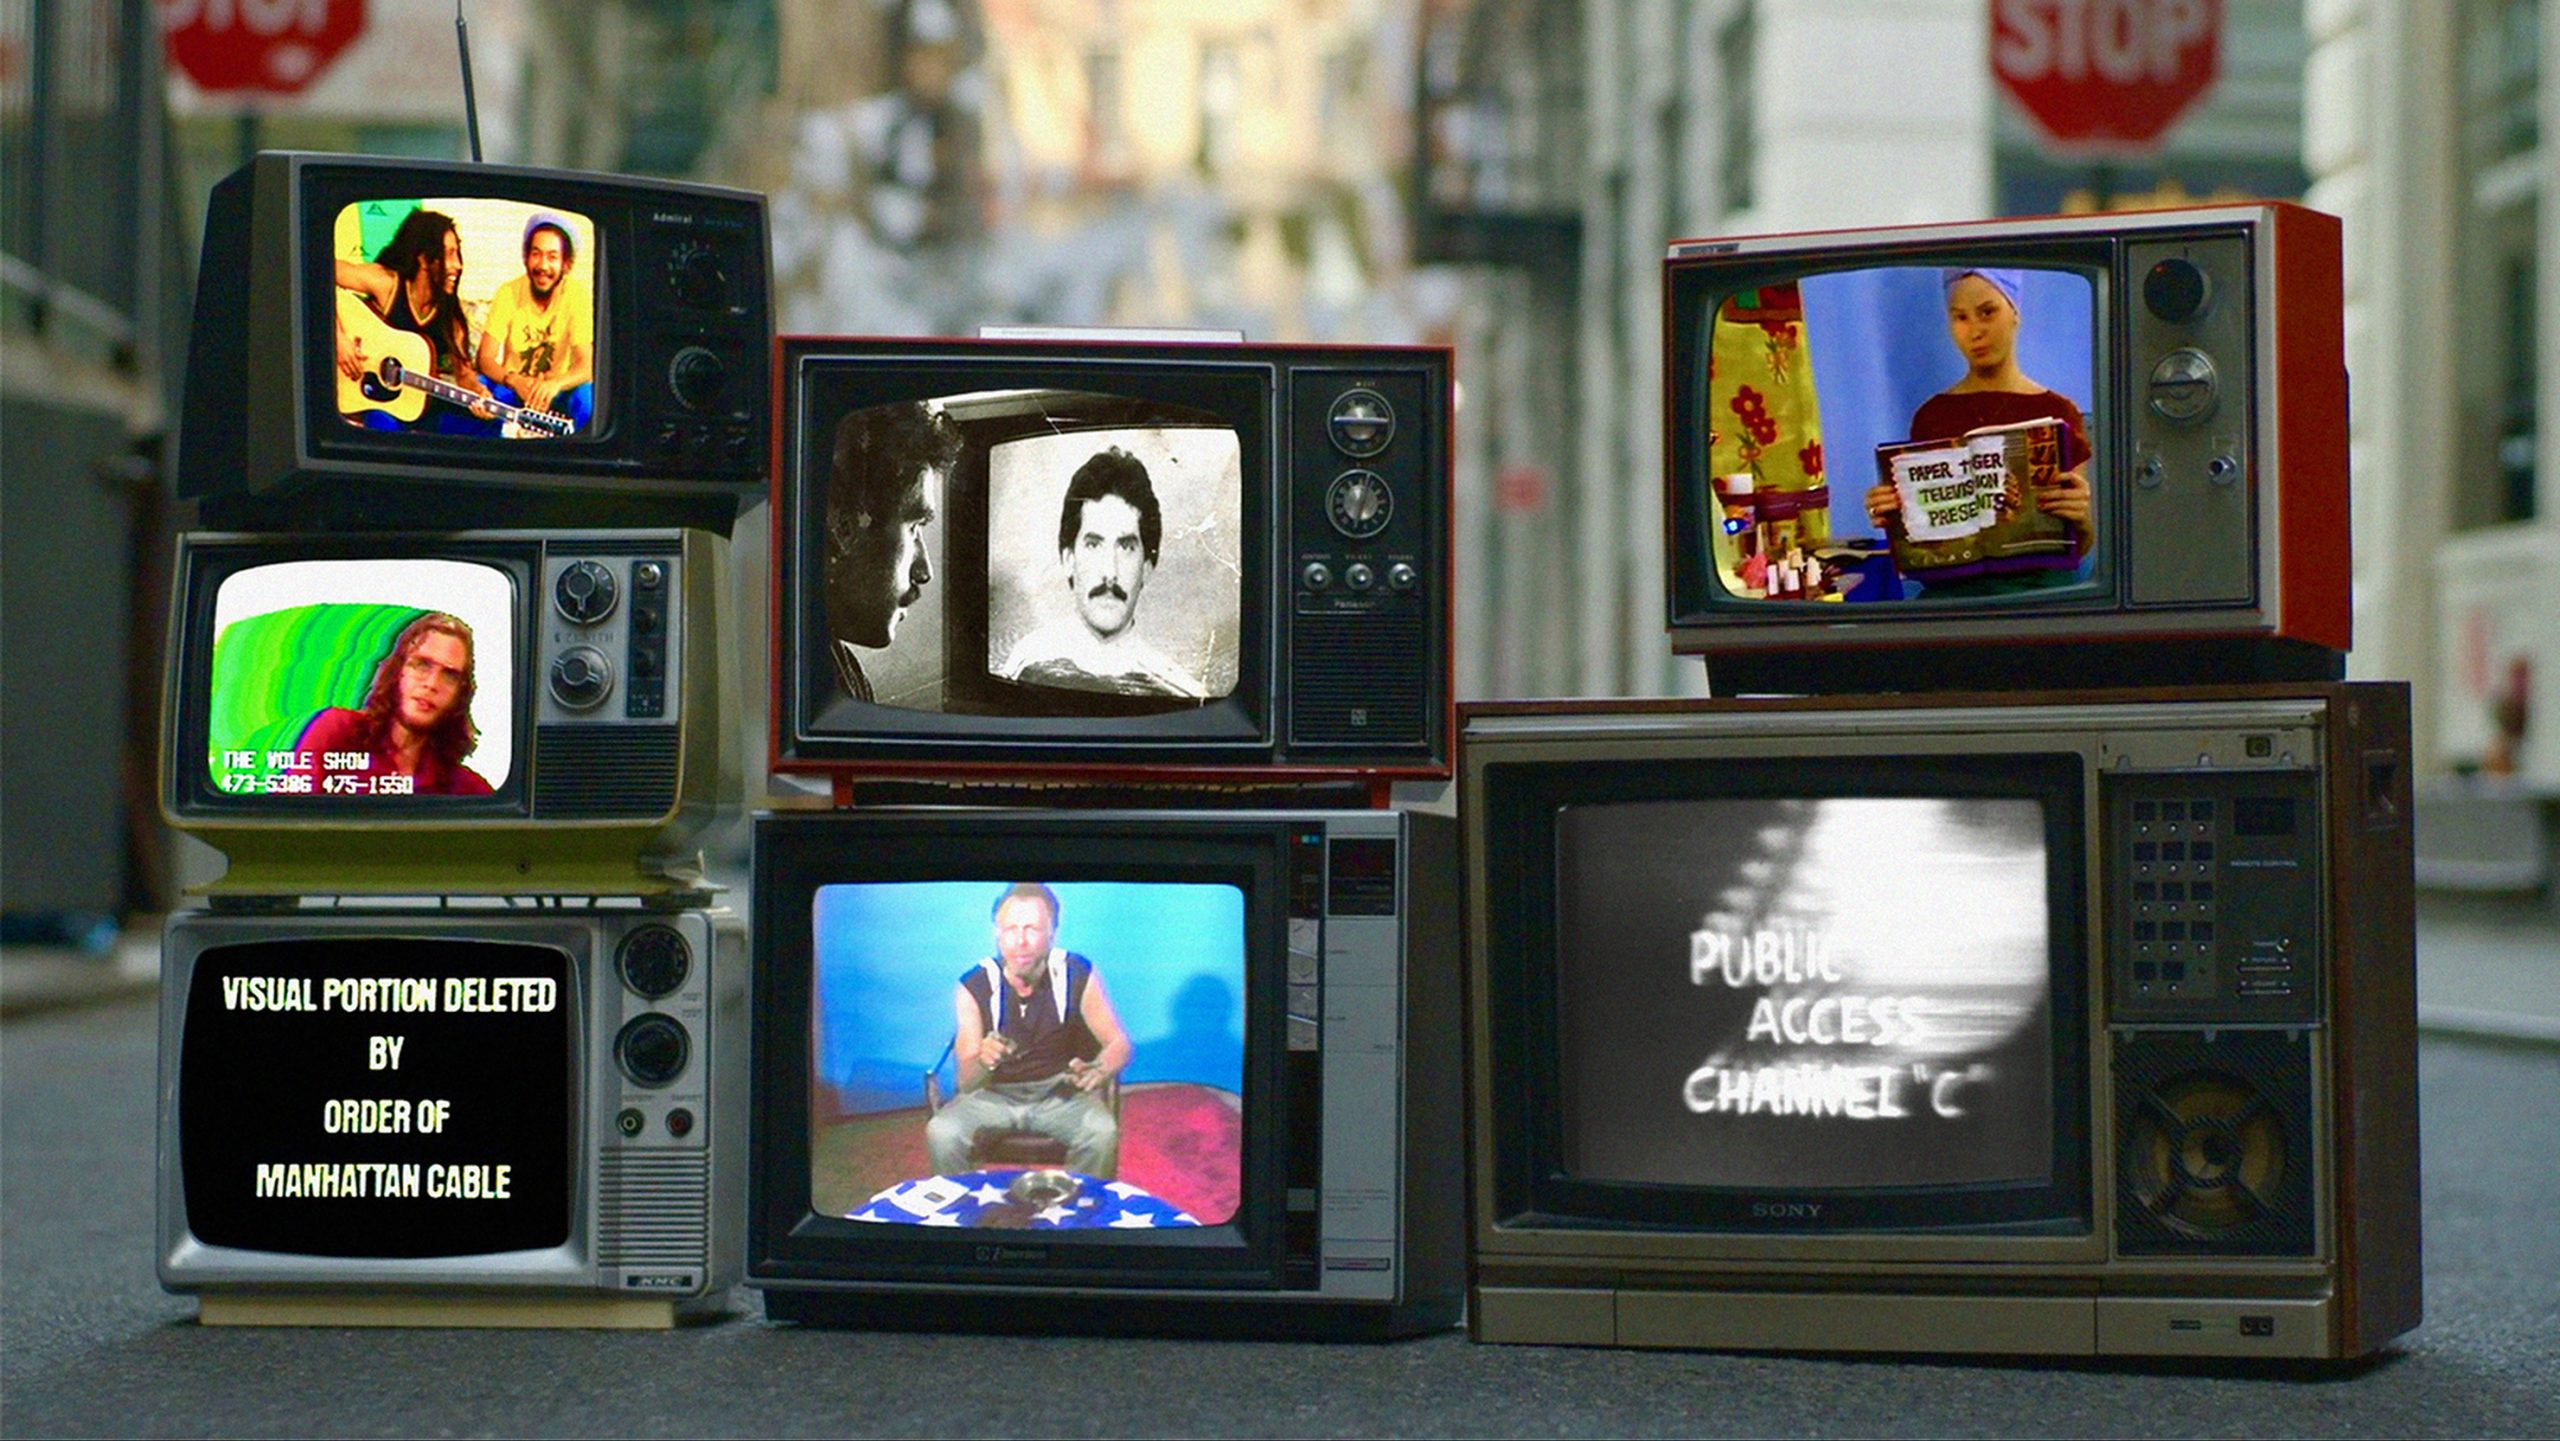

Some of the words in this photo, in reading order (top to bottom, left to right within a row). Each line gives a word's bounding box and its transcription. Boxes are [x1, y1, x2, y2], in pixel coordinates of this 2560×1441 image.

[1994, 0, 2205, 80] STOP
[1909, 461, 1953, 482] PAPER
[1918, 472, 1999, 503] TELEVISION
[1927, 492, 2006, 527] PRESENTS
[223, 751, 256, 769] THE
[265, 751, 313, 770] VOLE
[323, 752, 370, 770] SHOW
[1689, 929, 1841, 987] PUBLIC
[222, 976, 317, 1012] VISUAL
[323, 978, 437, 1013] PORTION
[444, 977, 556, 1012] DELETED
[1747, 996, 1929, 1046] ACCESS
[369, 1036, 404, 1070] BY
[1683, 1065, 1909, 1118] CHANNEL
[324, 1100, 410, 1133] ORDER
[417, 1100, 450, 1133] OF
[256, 1164, 420, 1198] MANHATTAN
[427, 1164, 512, 1198] CABLE
[1752, 1203, 1822, 1217] SONY
